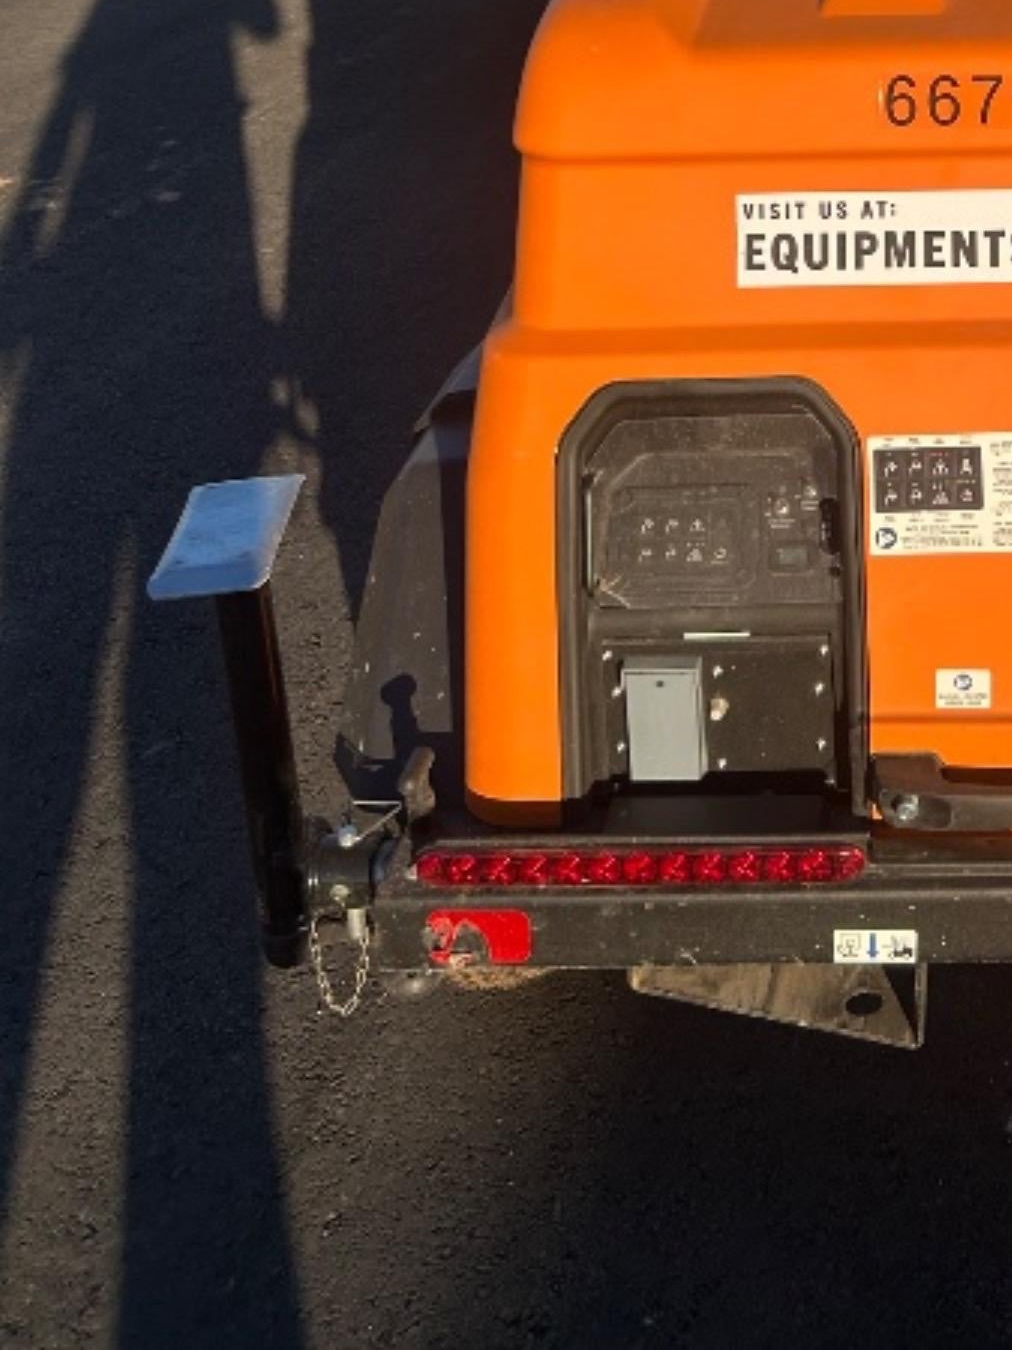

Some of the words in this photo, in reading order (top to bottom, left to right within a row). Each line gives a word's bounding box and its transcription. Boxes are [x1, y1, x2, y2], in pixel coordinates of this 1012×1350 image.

[743, 202, 805, 220] VISIT
[819, 201, 848, 220] US
[860, 200, 896, 219] AT:
